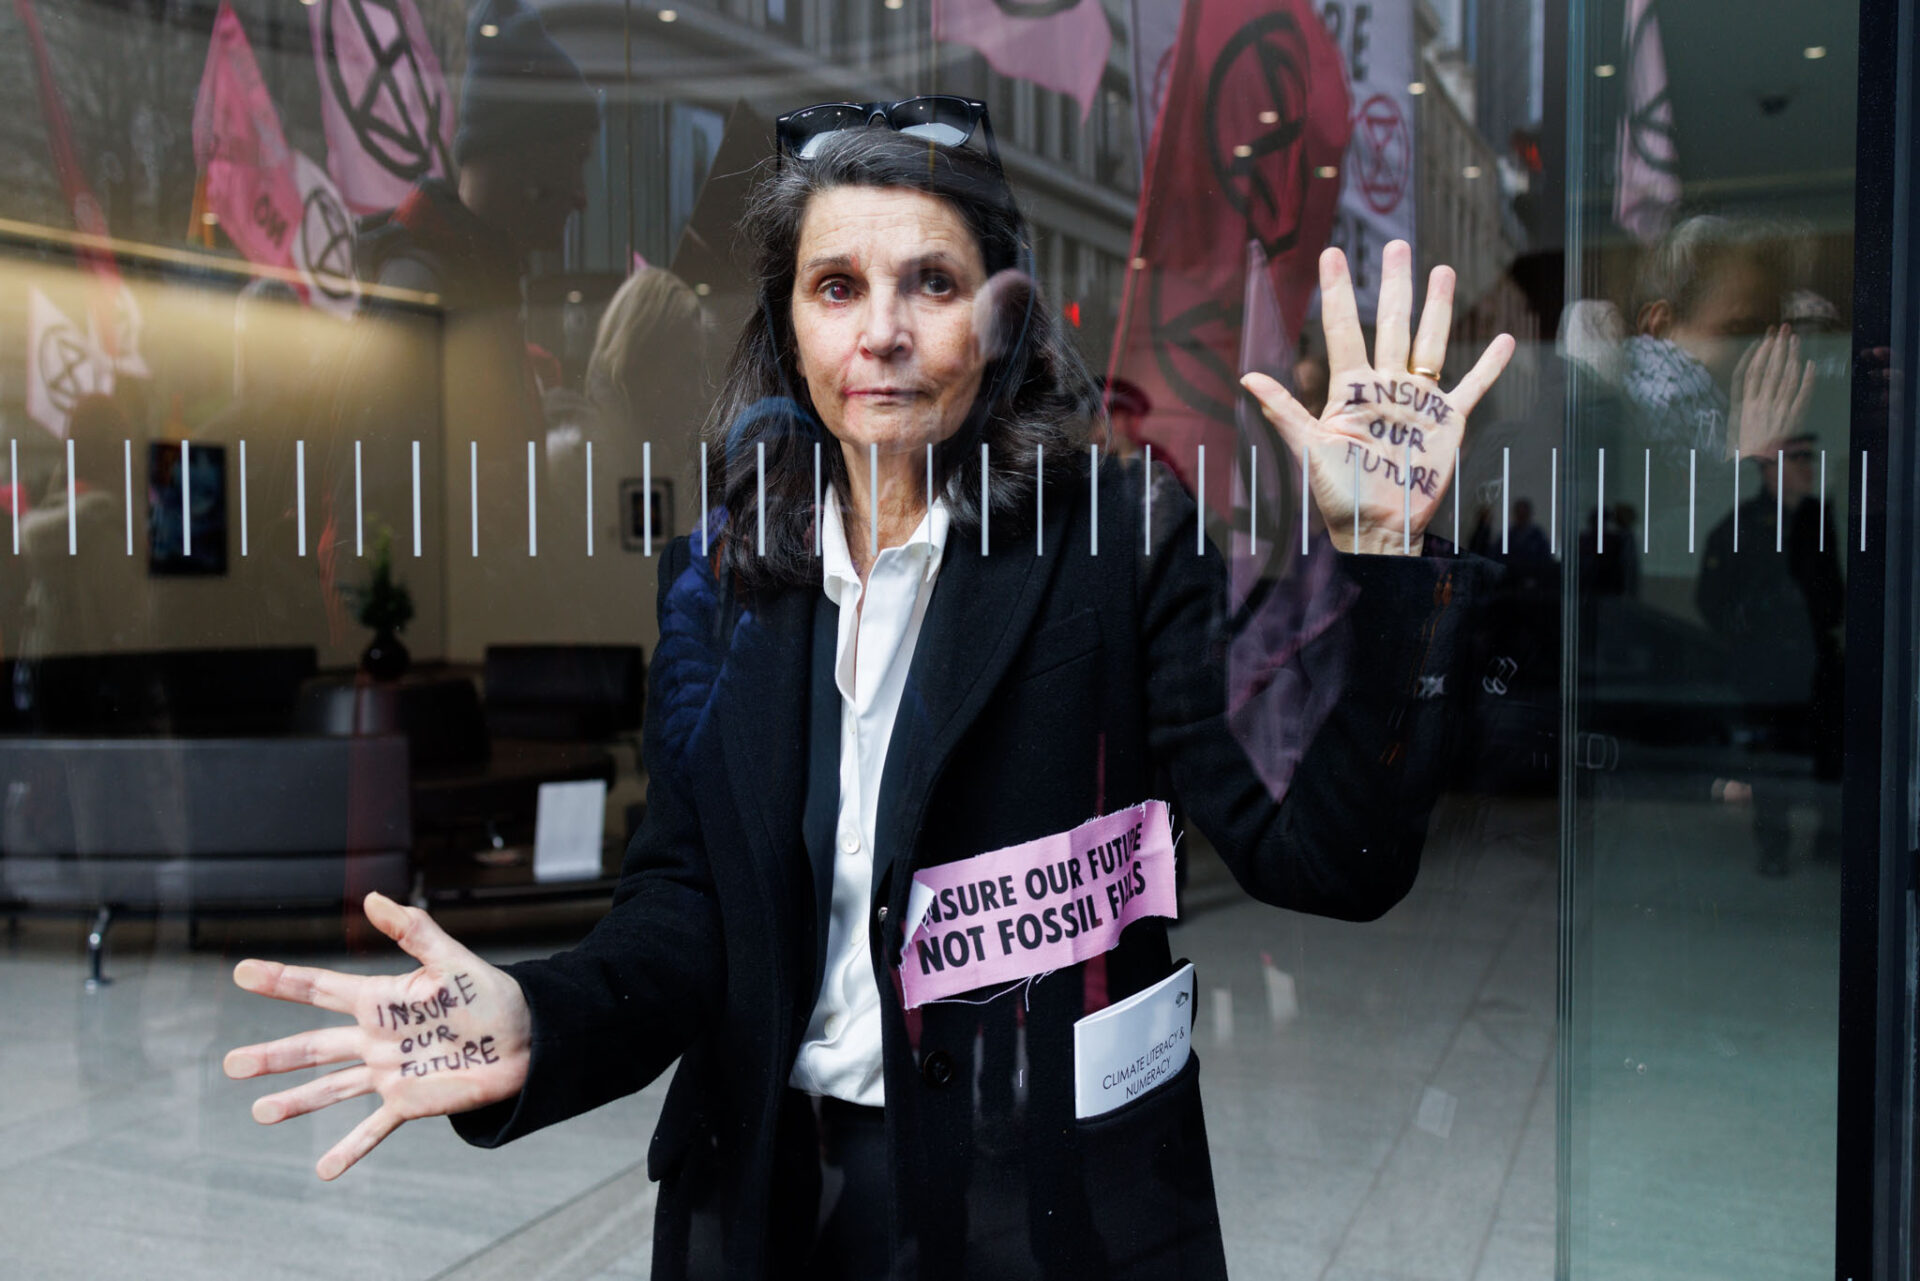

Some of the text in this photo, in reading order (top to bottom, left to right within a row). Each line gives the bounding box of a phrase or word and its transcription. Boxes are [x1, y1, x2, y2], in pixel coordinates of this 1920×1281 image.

[1345, 380, 1454, 425] INSURE
[1369, 417, 1426, 453] OUR
[1345, 441, 1440, 499] FUTURE
[922, 875, 1018, 927] NSURE
[1025, 858, 1084, 900] OUR
[916, 925, 986, 975] NOT
[998, 895, 1103, 956] FOSSIL
[377, 973, 477, 1031] INSURE
[400, 1025, 459, 1053] OUR
[400, 1035, 499, 1077] FUTURE
[1102, 1056, 1145, 1090] CLIMATE
[1147, 1029, 1179, 1066] LITERACY
[1179, 1026, 1185, 1039] &
[1125, 1056, 1171, 1099] NUMERACY
